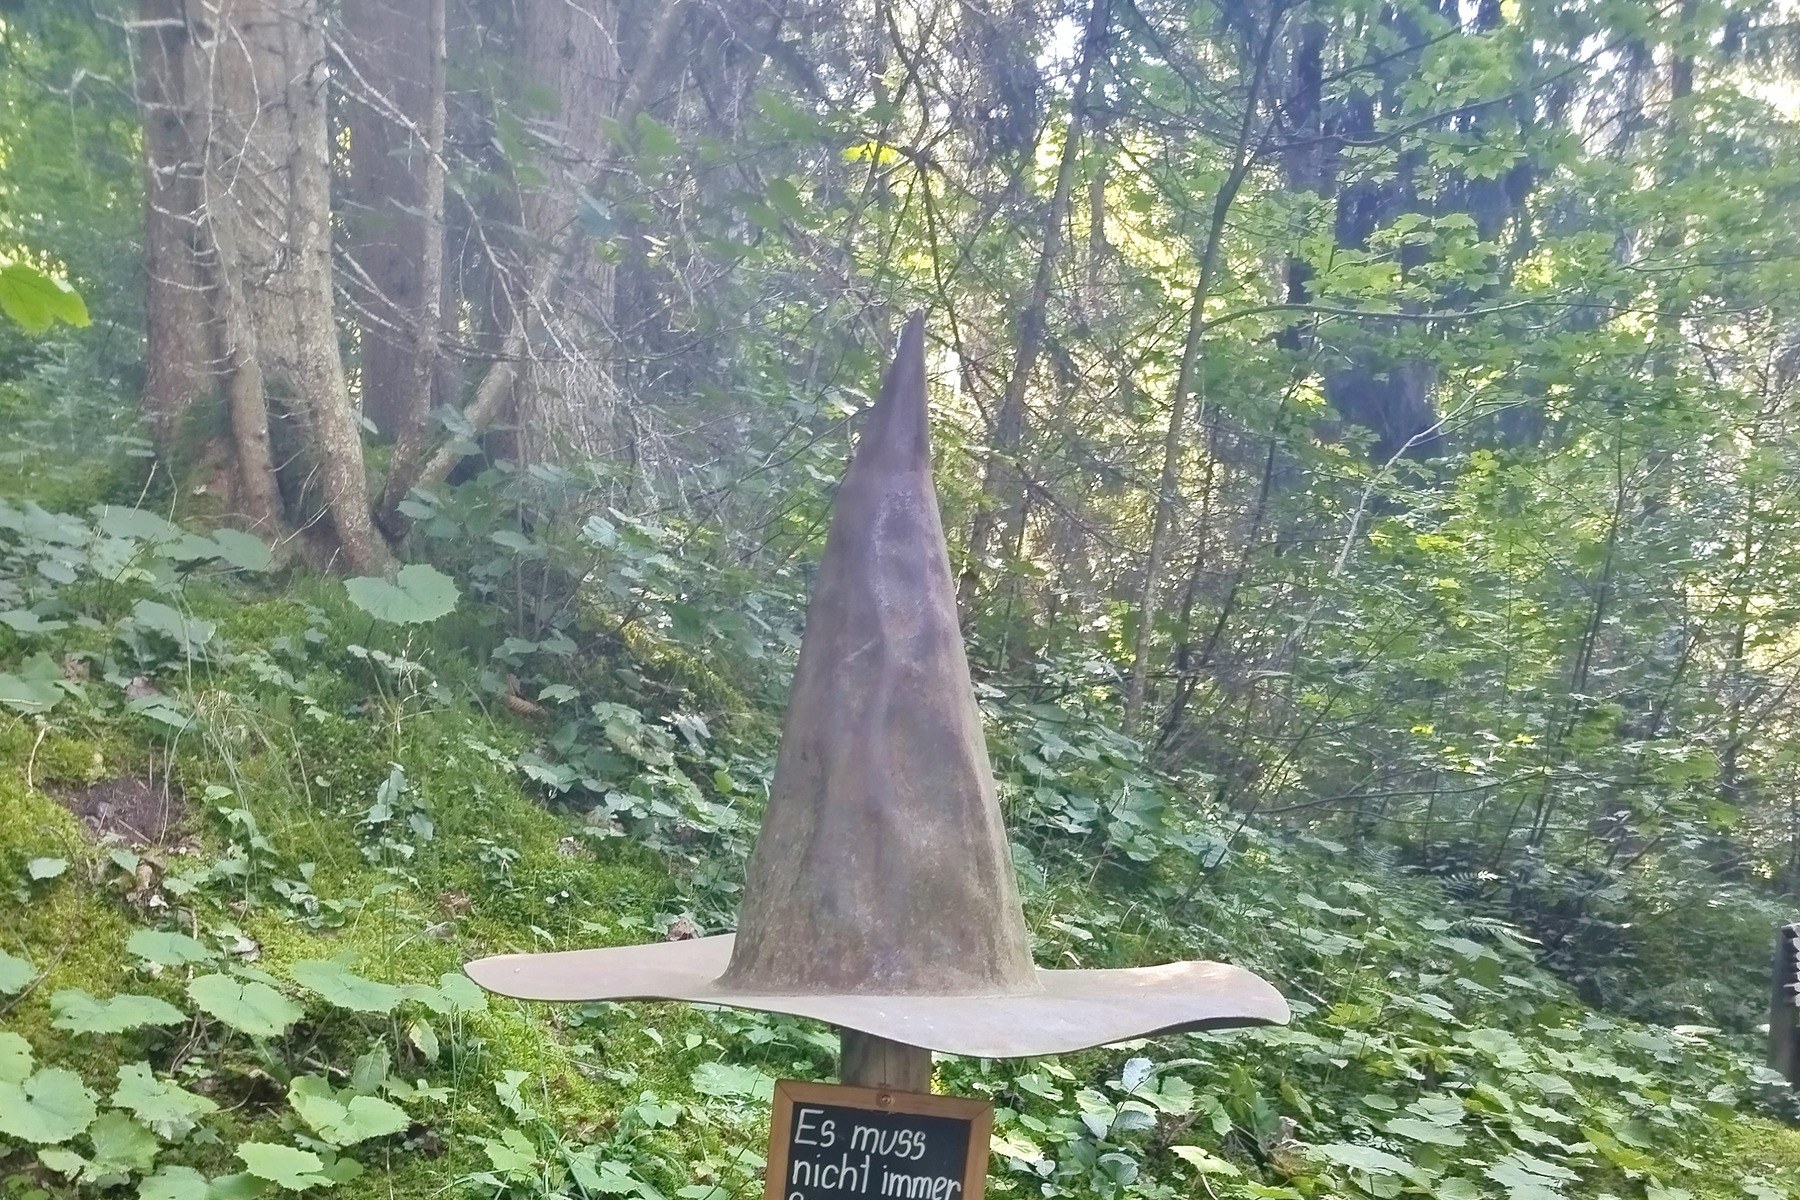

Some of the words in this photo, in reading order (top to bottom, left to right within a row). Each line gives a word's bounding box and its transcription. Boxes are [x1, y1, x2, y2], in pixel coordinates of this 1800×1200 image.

[794, 1108, 835, 1148] Es
[850, 1124, 926, 1160] muss
[792, 1153, 870, 1194] nicht
